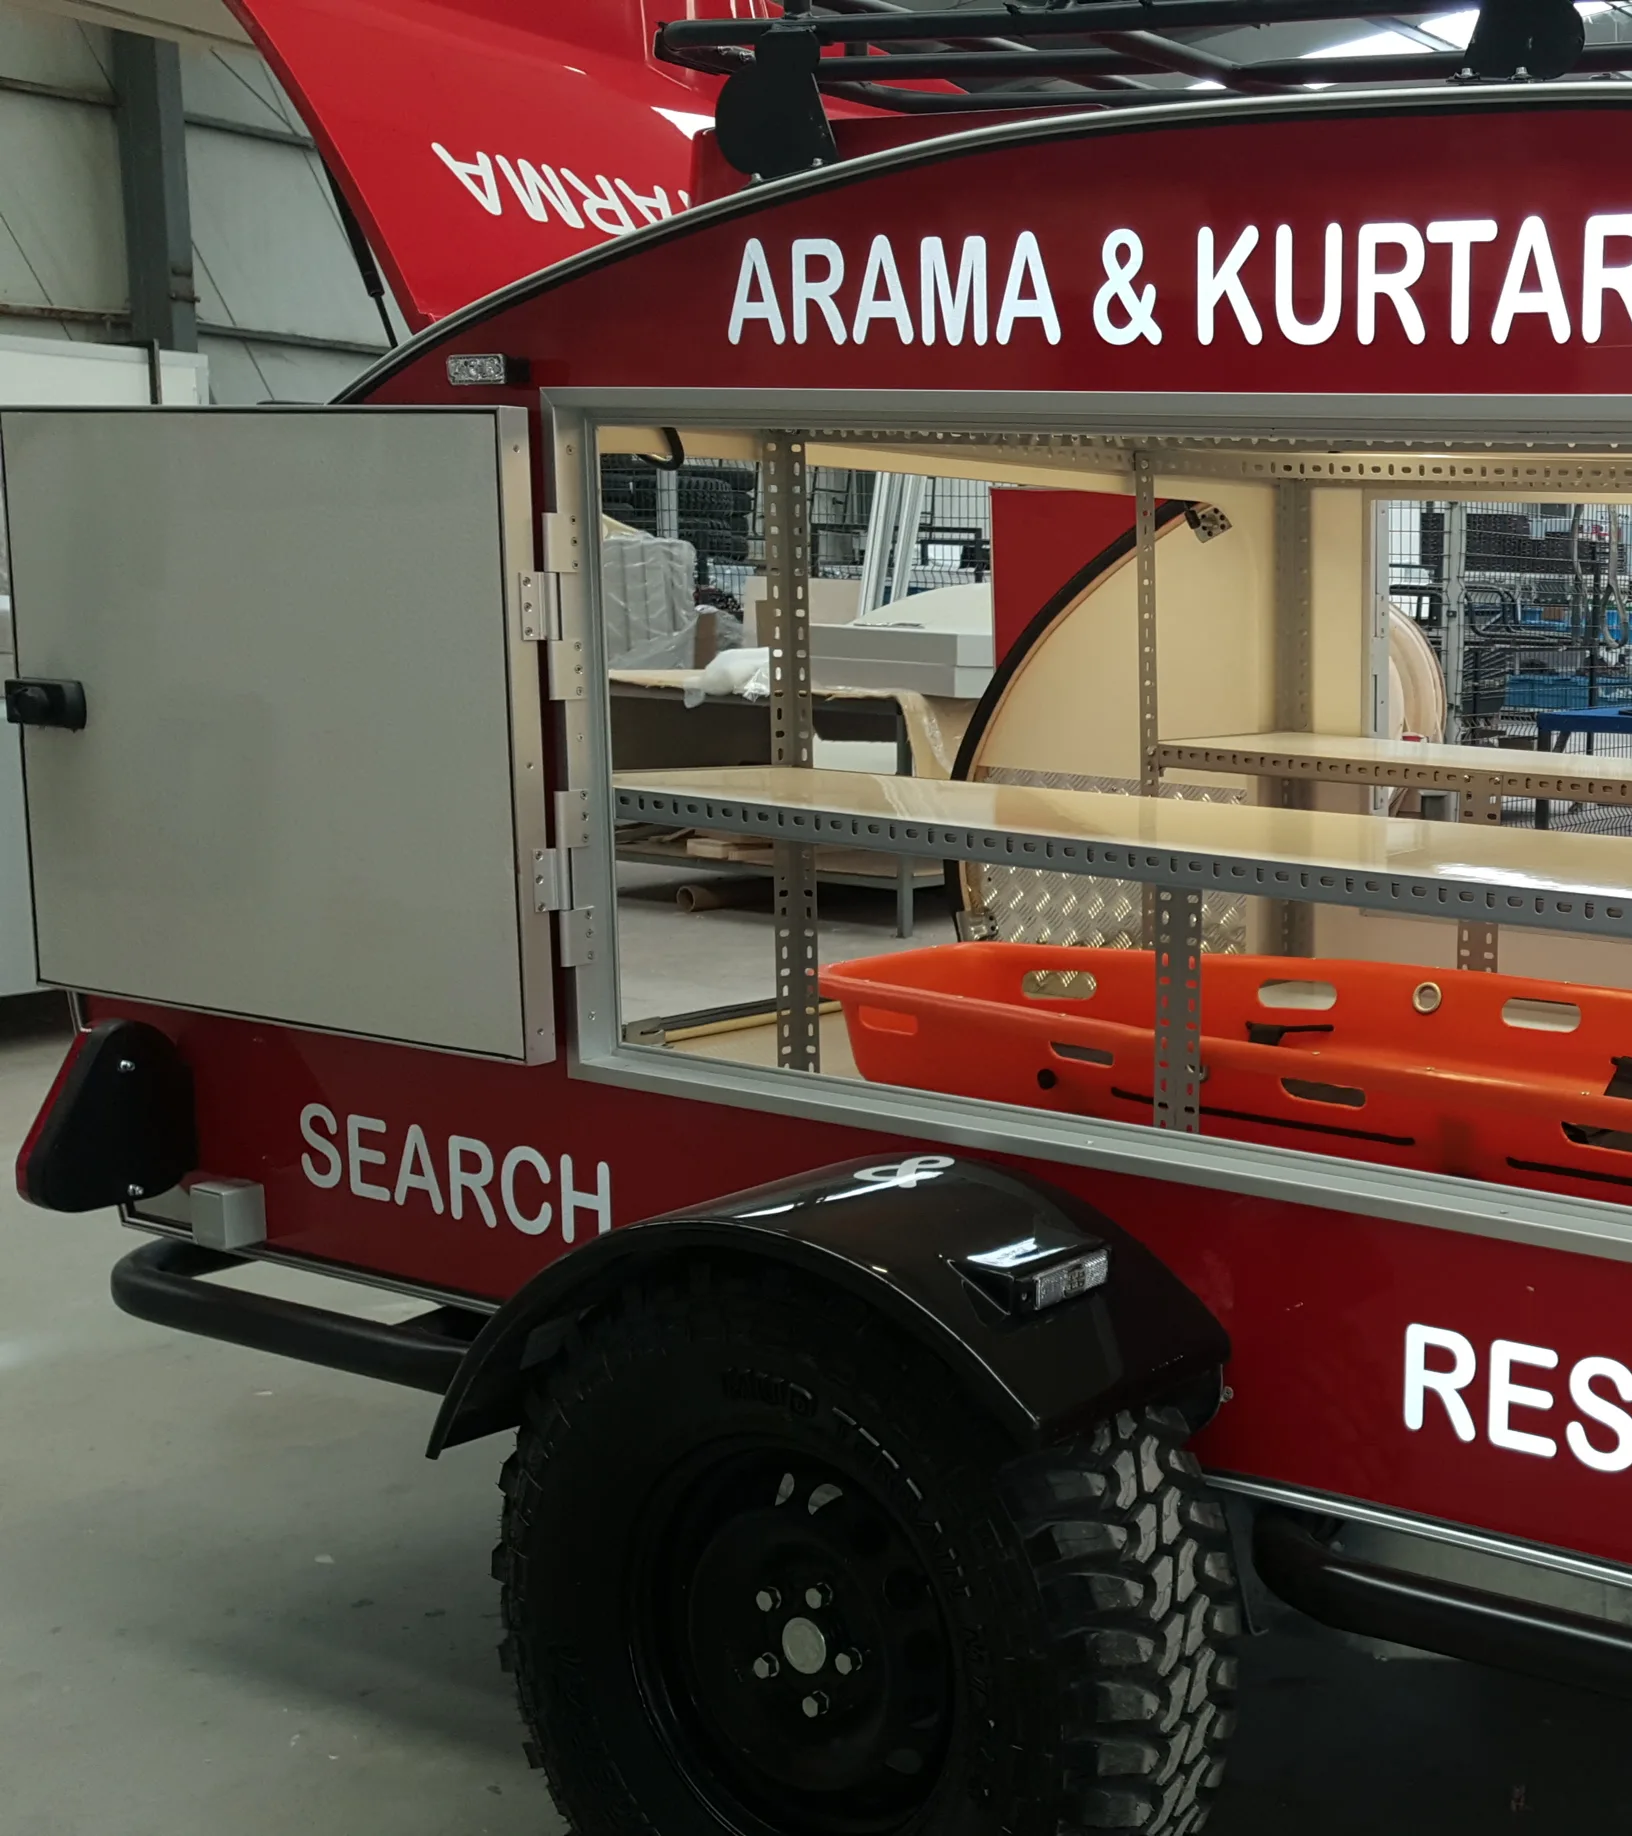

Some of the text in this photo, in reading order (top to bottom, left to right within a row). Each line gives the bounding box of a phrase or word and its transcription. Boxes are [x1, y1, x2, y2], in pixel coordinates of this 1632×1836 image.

[431, 142, 691, 236] ARMA
[727, 231, 1062, 347] ARAMA
[1092, 228, 1163, 346] &
[300, 1103, 612, 1244] SEARCH
